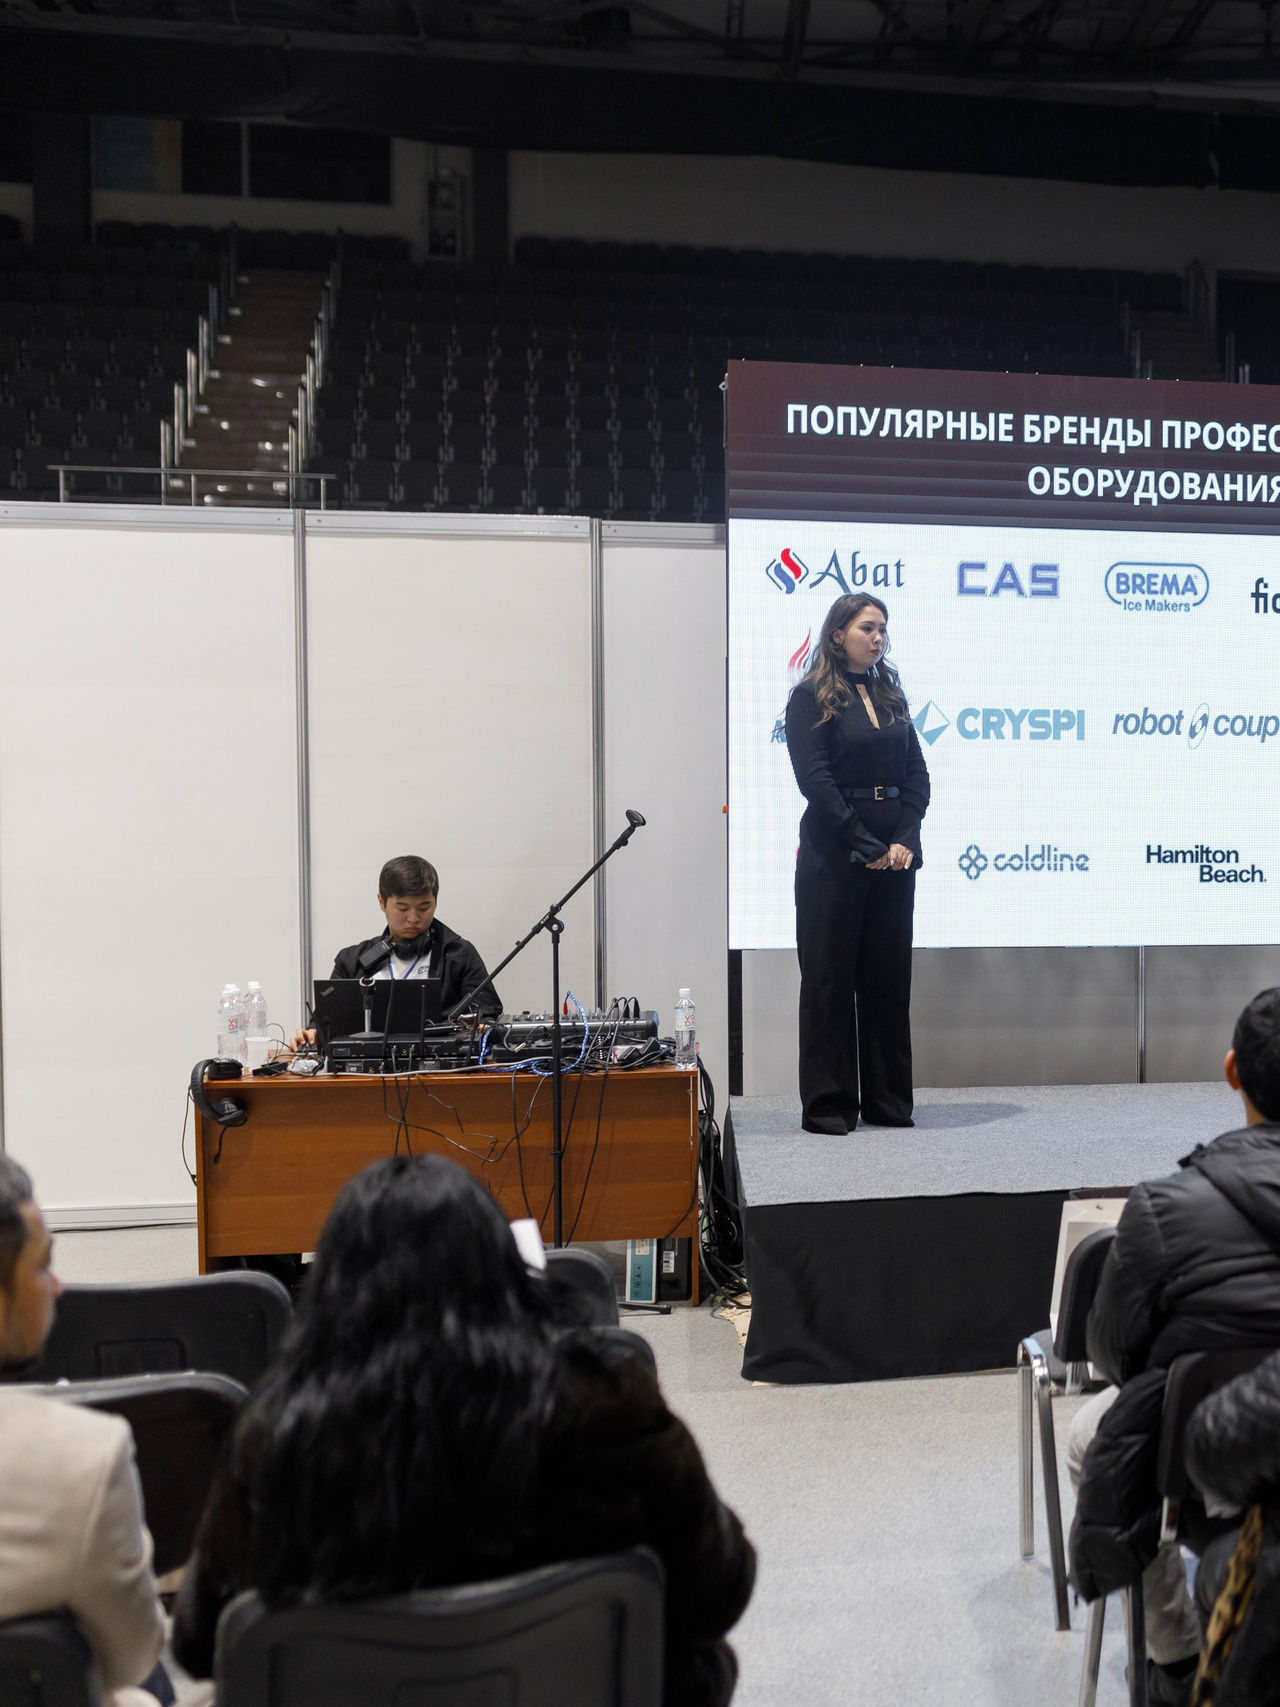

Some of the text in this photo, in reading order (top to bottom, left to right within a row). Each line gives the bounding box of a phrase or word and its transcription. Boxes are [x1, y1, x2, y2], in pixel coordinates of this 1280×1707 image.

[786, 403, 1014, 443] ПОПУЛЯРНЫЕ
[1023, 413, 1152, 454] БРЕНДЫ
[808, 548, 906, 595] Abat
[956, 560, 1060, 598] CAS
[1115, 572, 1199, 596] BREMA
[1123, 598, 1191, 613] Ice Makers
[956, 707, 1086, 741] CRYSPI
[1112, 707, 1185, 736] robot
[993, 844, 1090, 872] coldline
[1145, 844, 1240, 864] Hamilton
